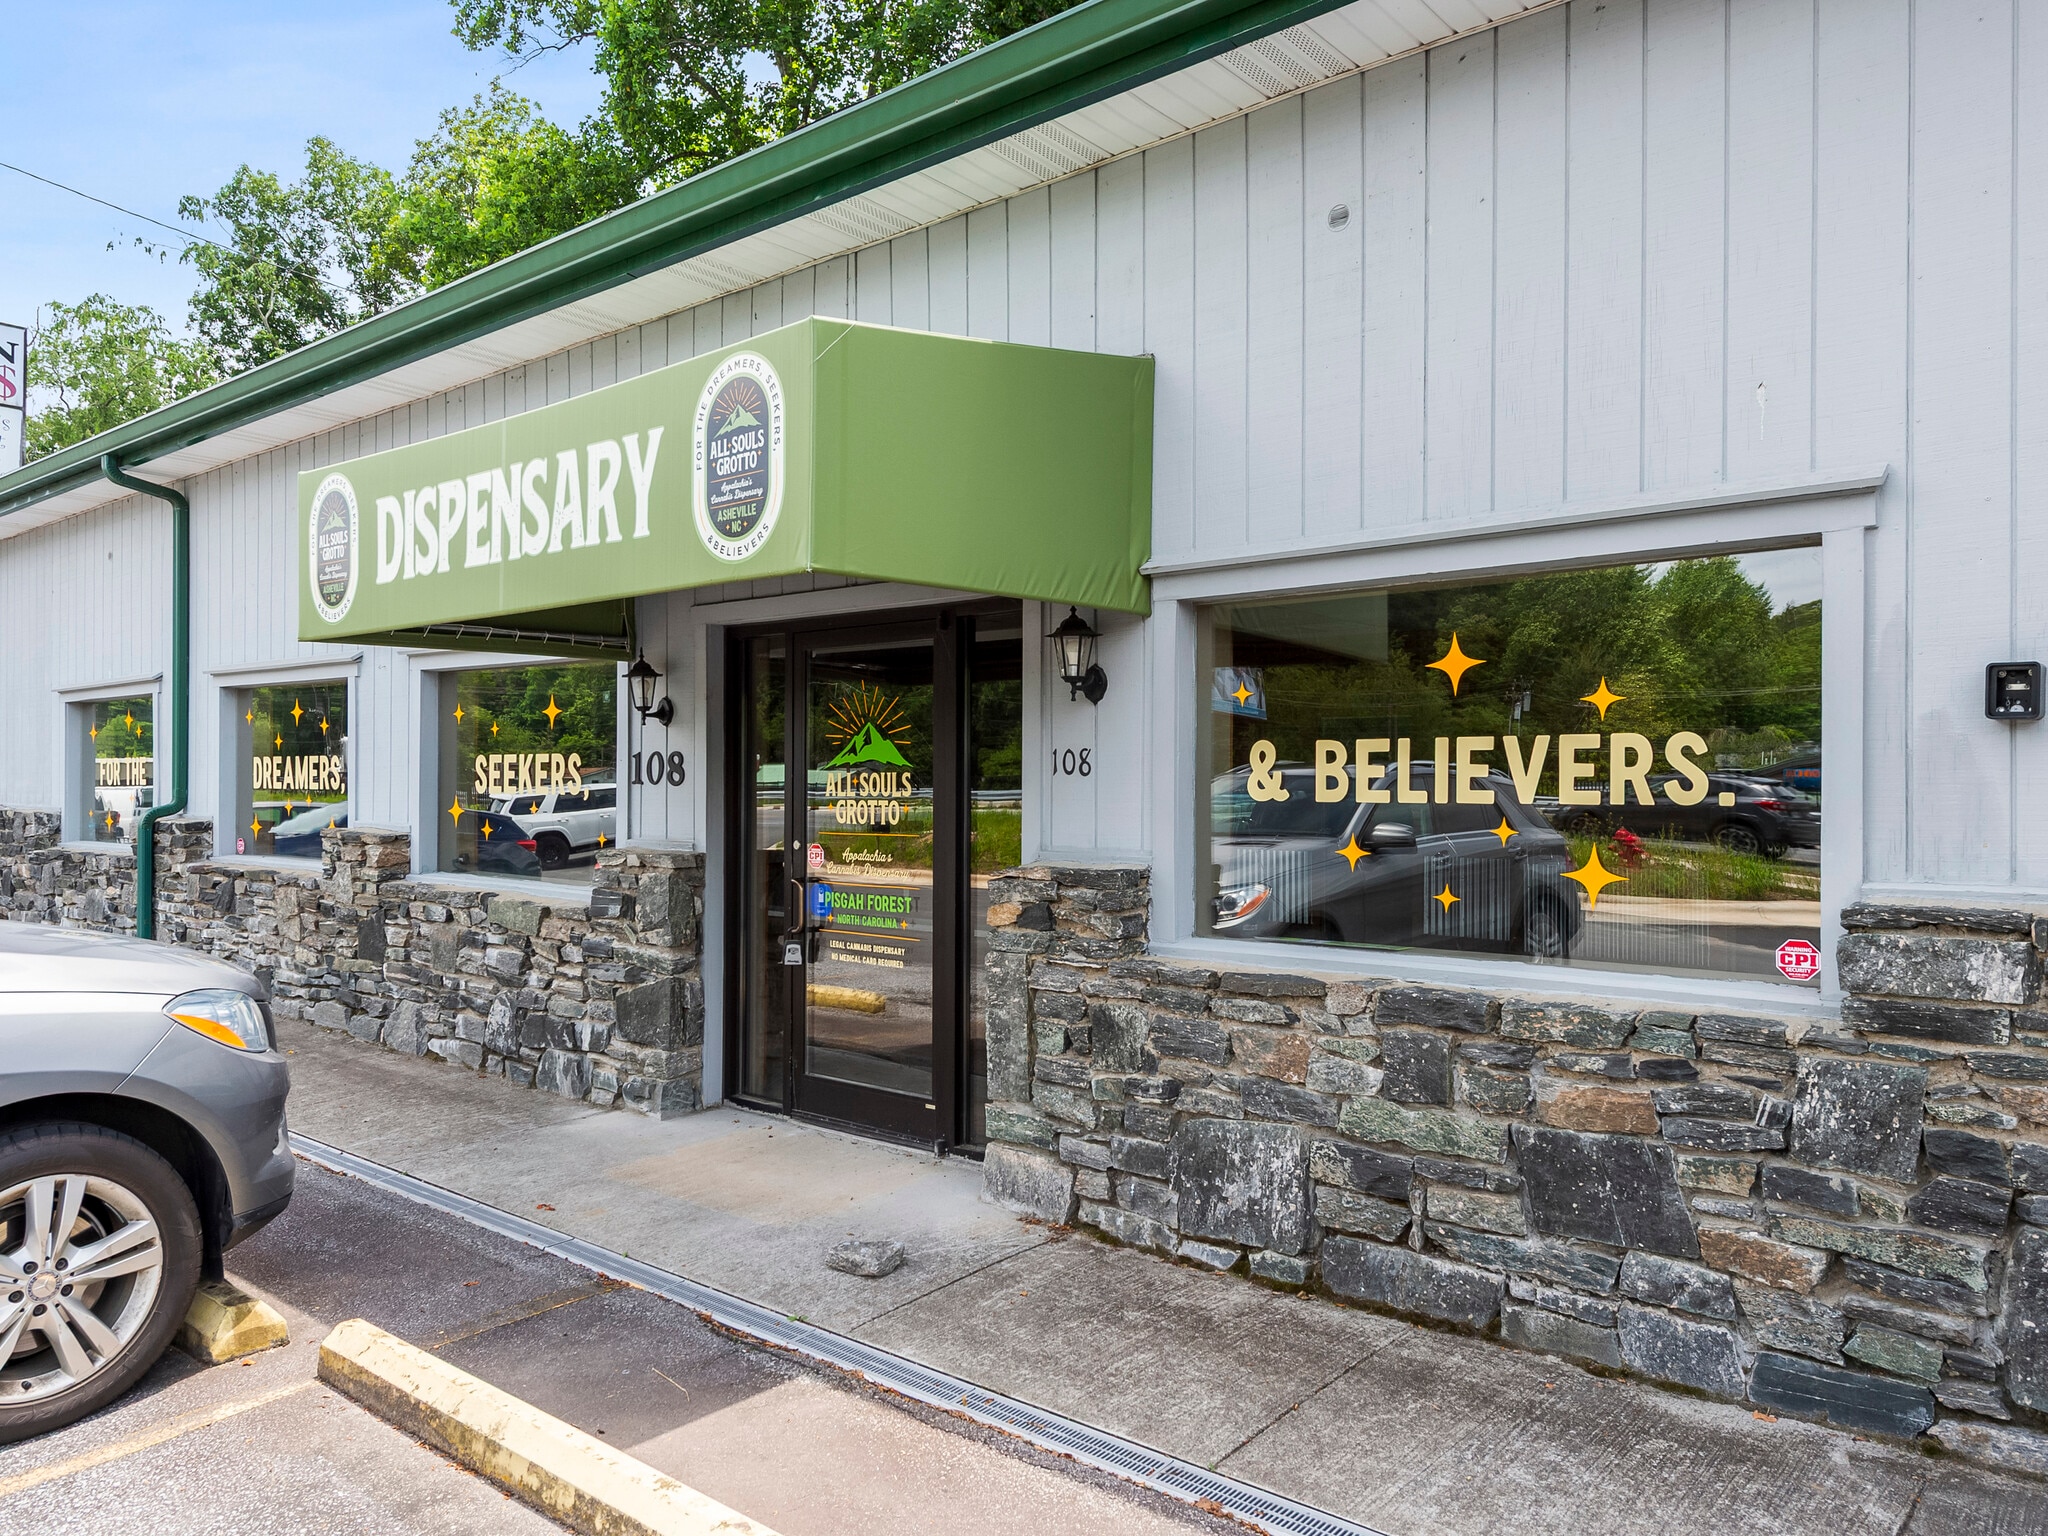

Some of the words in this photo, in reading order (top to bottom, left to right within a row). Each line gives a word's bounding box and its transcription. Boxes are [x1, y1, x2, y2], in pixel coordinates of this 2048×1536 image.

[696, 402, 708, 432] THE
[707, 358, 763, 396] DREAMERS,
[765, 374, 781, 452] SEEKERS,
[710, 438, 730, 460] ALL
[731, 429, 765, 454] SOULS
[716, 450, 758, 476] GROTTO
[375, 425, 665, 585] DISPENSARY
[717, 503, 757, 522] ASHEVILLE
[731, 520, 742, 533] NC
[319, 535, 330, 549] ALL
[330, 530, 348, 546] SOULS
[322, 545, 345, 561] GROTTO
[100, 758, 121, 786] FOR
[125, 757, 147, 786] THE
[253, 755, 347, 793] DREAMERS,
[632, 750, 686, 787] 108
[1052, 748, 1092, 777] 108
[1247, 739, 1291, 802] &
[1315, 731, 1736, 807] BELIEVERS.
[474, 752, 590, 801] SEEKERS,
[825, 772, 856, 797] ALL
[859, 772, 912, 797] SOULS
[836, 800, 900, 825] GROTTO
[809, 851, 823, 861] CPI
[842, 847, 893, 863] Appalachias
[826, 861, 861, 875] Cannabis
[824, 891, 864, 910] PISGAH
[867, 894, 912, 914] FOREST
[837, 913, 860, 927] NORTH
[862, 915, 899, 930] CAROLINA
[829, 940, 846, 949] LEGAL
[846, 942, 873, 952] CANNABIS
[872, 945, 906, 956] DISPENSARY
[1780, 953, 1817, 967] CPI
[839, 954, 862, 963] MEDICAL
[862, 956, 877, 965] CARD
[877, 959, 904, 969] REQUIRED
